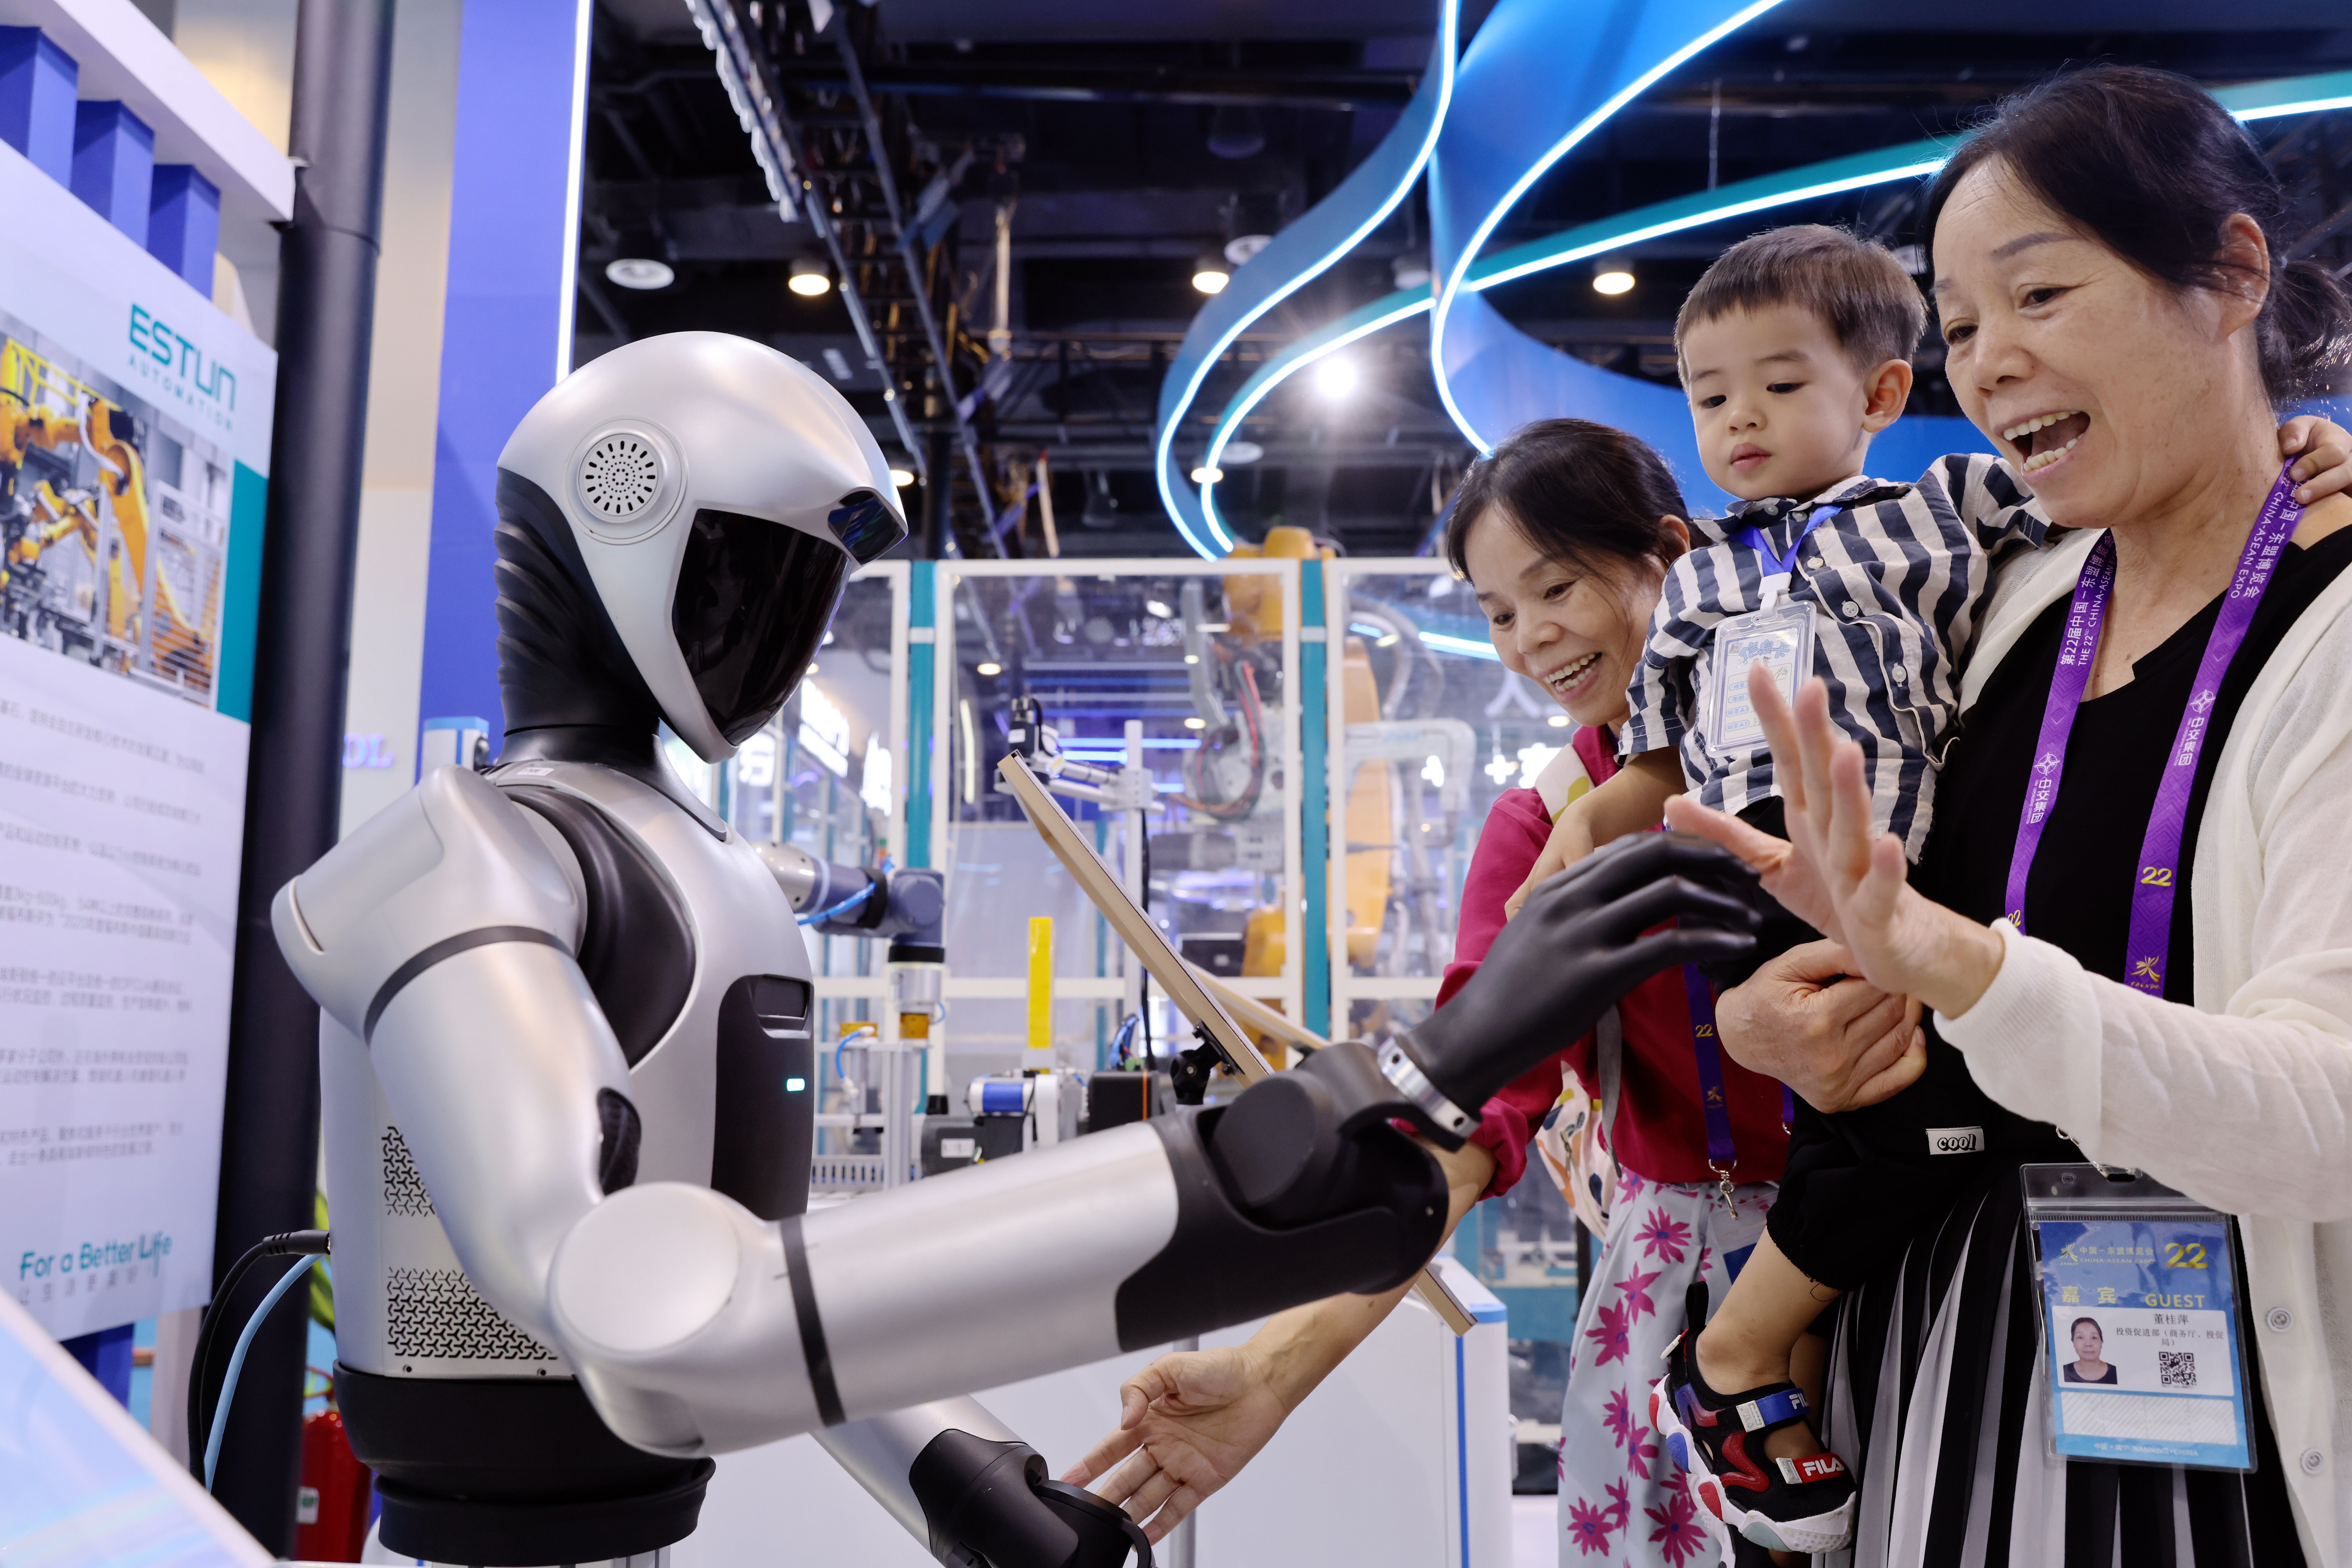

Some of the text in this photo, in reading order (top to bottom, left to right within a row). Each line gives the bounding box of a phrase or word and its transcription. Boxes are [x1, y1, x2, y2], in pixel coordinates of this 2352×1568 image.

[130, 304, 236, 411] ESTUN
[2243, 492, 2283, 565] CHINA-ASEAN
[2231, 569, 2249, 599] EXPO
[2078, 648, 2090, 666] THE
[2088, 565, 2113, 627] CHINA-ASEAN
[1739, 639, 1790, 660] 信息卡
[2178, 717, 2205, 766] 中交集团
[2030, 778, 2052, 824] 中交集团
[2141, 866, 2172, 886] 22
[1695, 1024, 1713, 1038] 22
[20, 1231, 172, 1280] For a Better Life
[2164, 1242, 2208, 1269] 22
[2145, 1293, 2205, 1308] GUEST
[1789, 1392, 1810, 1410] FIL
[1802, 1457, 1845, 1476] FILA
